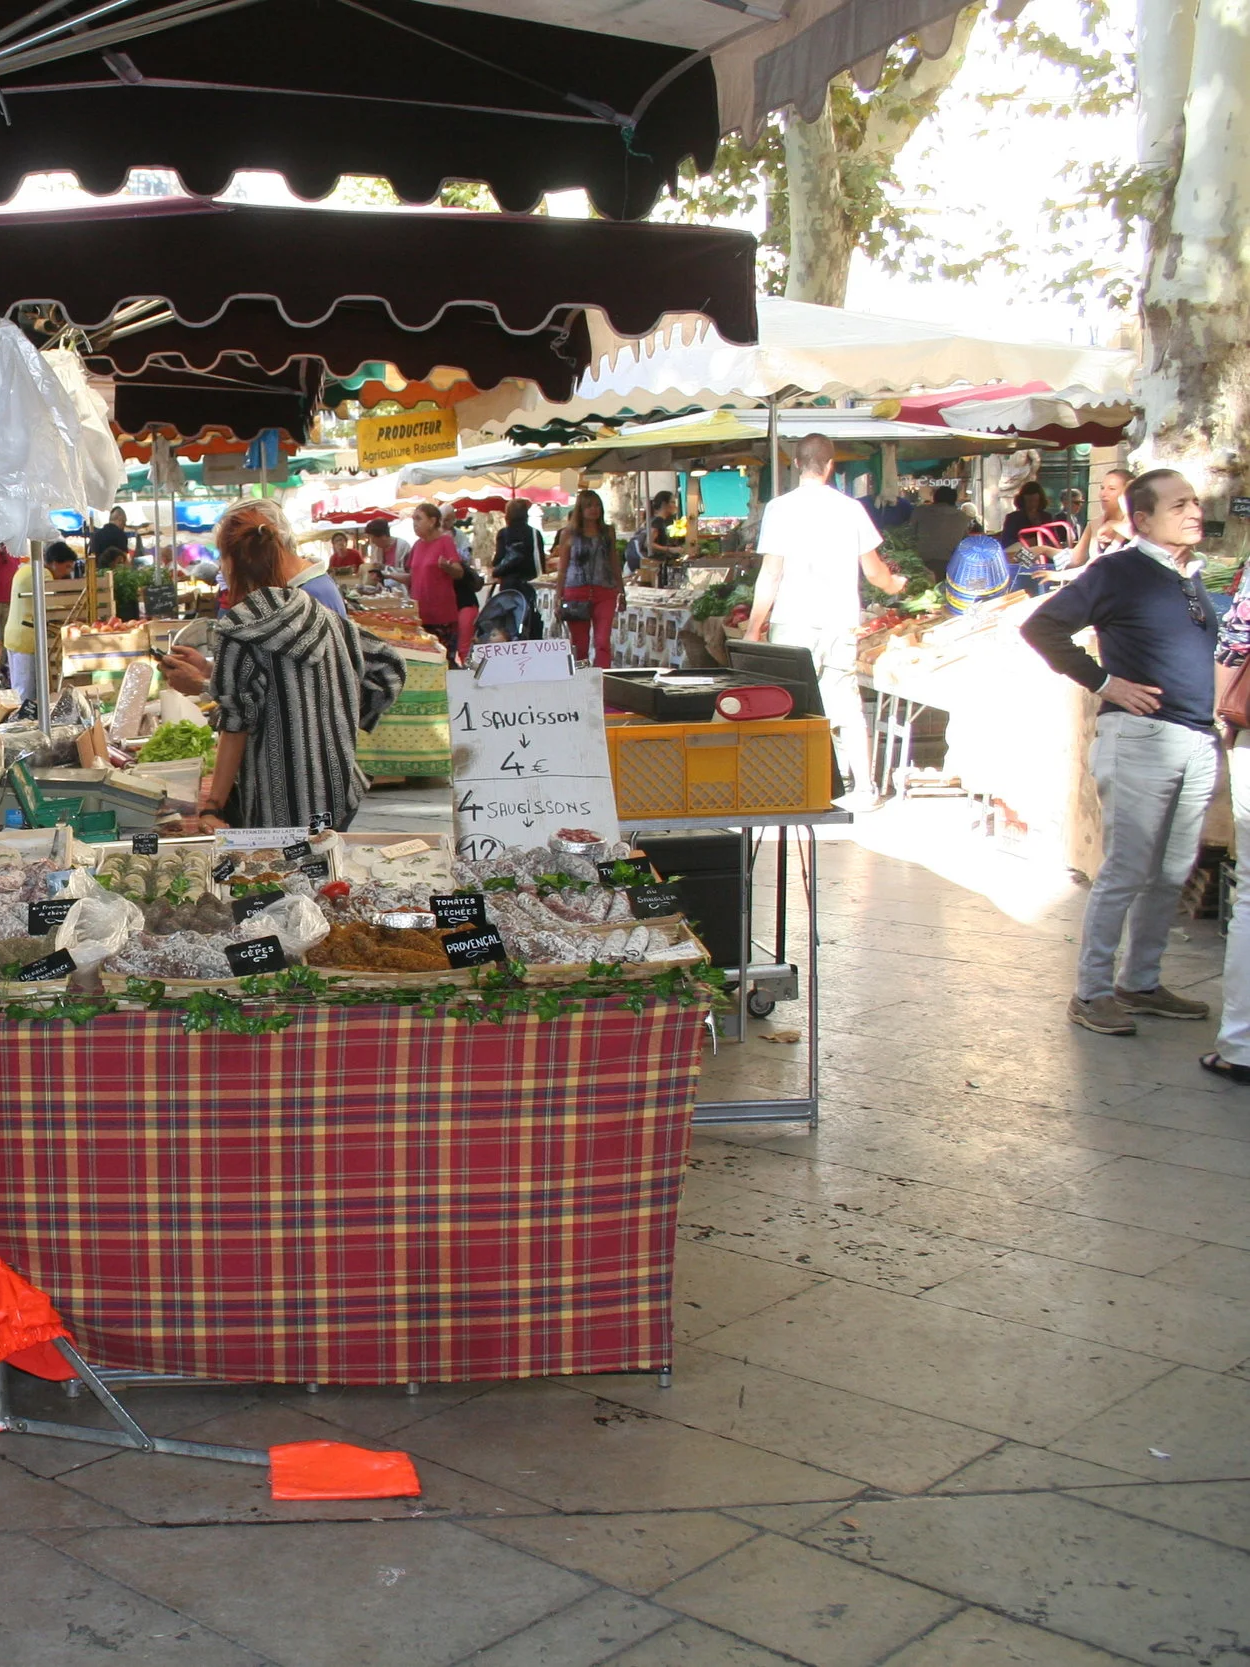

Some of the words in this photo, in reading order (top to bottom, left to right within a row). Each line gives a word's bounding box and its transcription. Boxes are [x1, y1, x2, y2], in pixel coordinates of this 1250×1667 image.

[377, 420, 443, 442] PRODUCTEUR
[362, 446, 412, 464] Agriculture
[476, 643, 529, 660] SERVEZ
[535, 640, 568, 653] VOUS
[453, 702, 478, 732] 1
[481, 705, 581, 730] SAUCISSON
[499, 751, 525, 776] 4
[531, 758, 550, 774] €
[457, 790, 484, 822] 4
[461, 838, 498, 862] 12
[435, 897, 476, 906] TOMATES
[446, 934, 502, 954] PROVENÇAL
